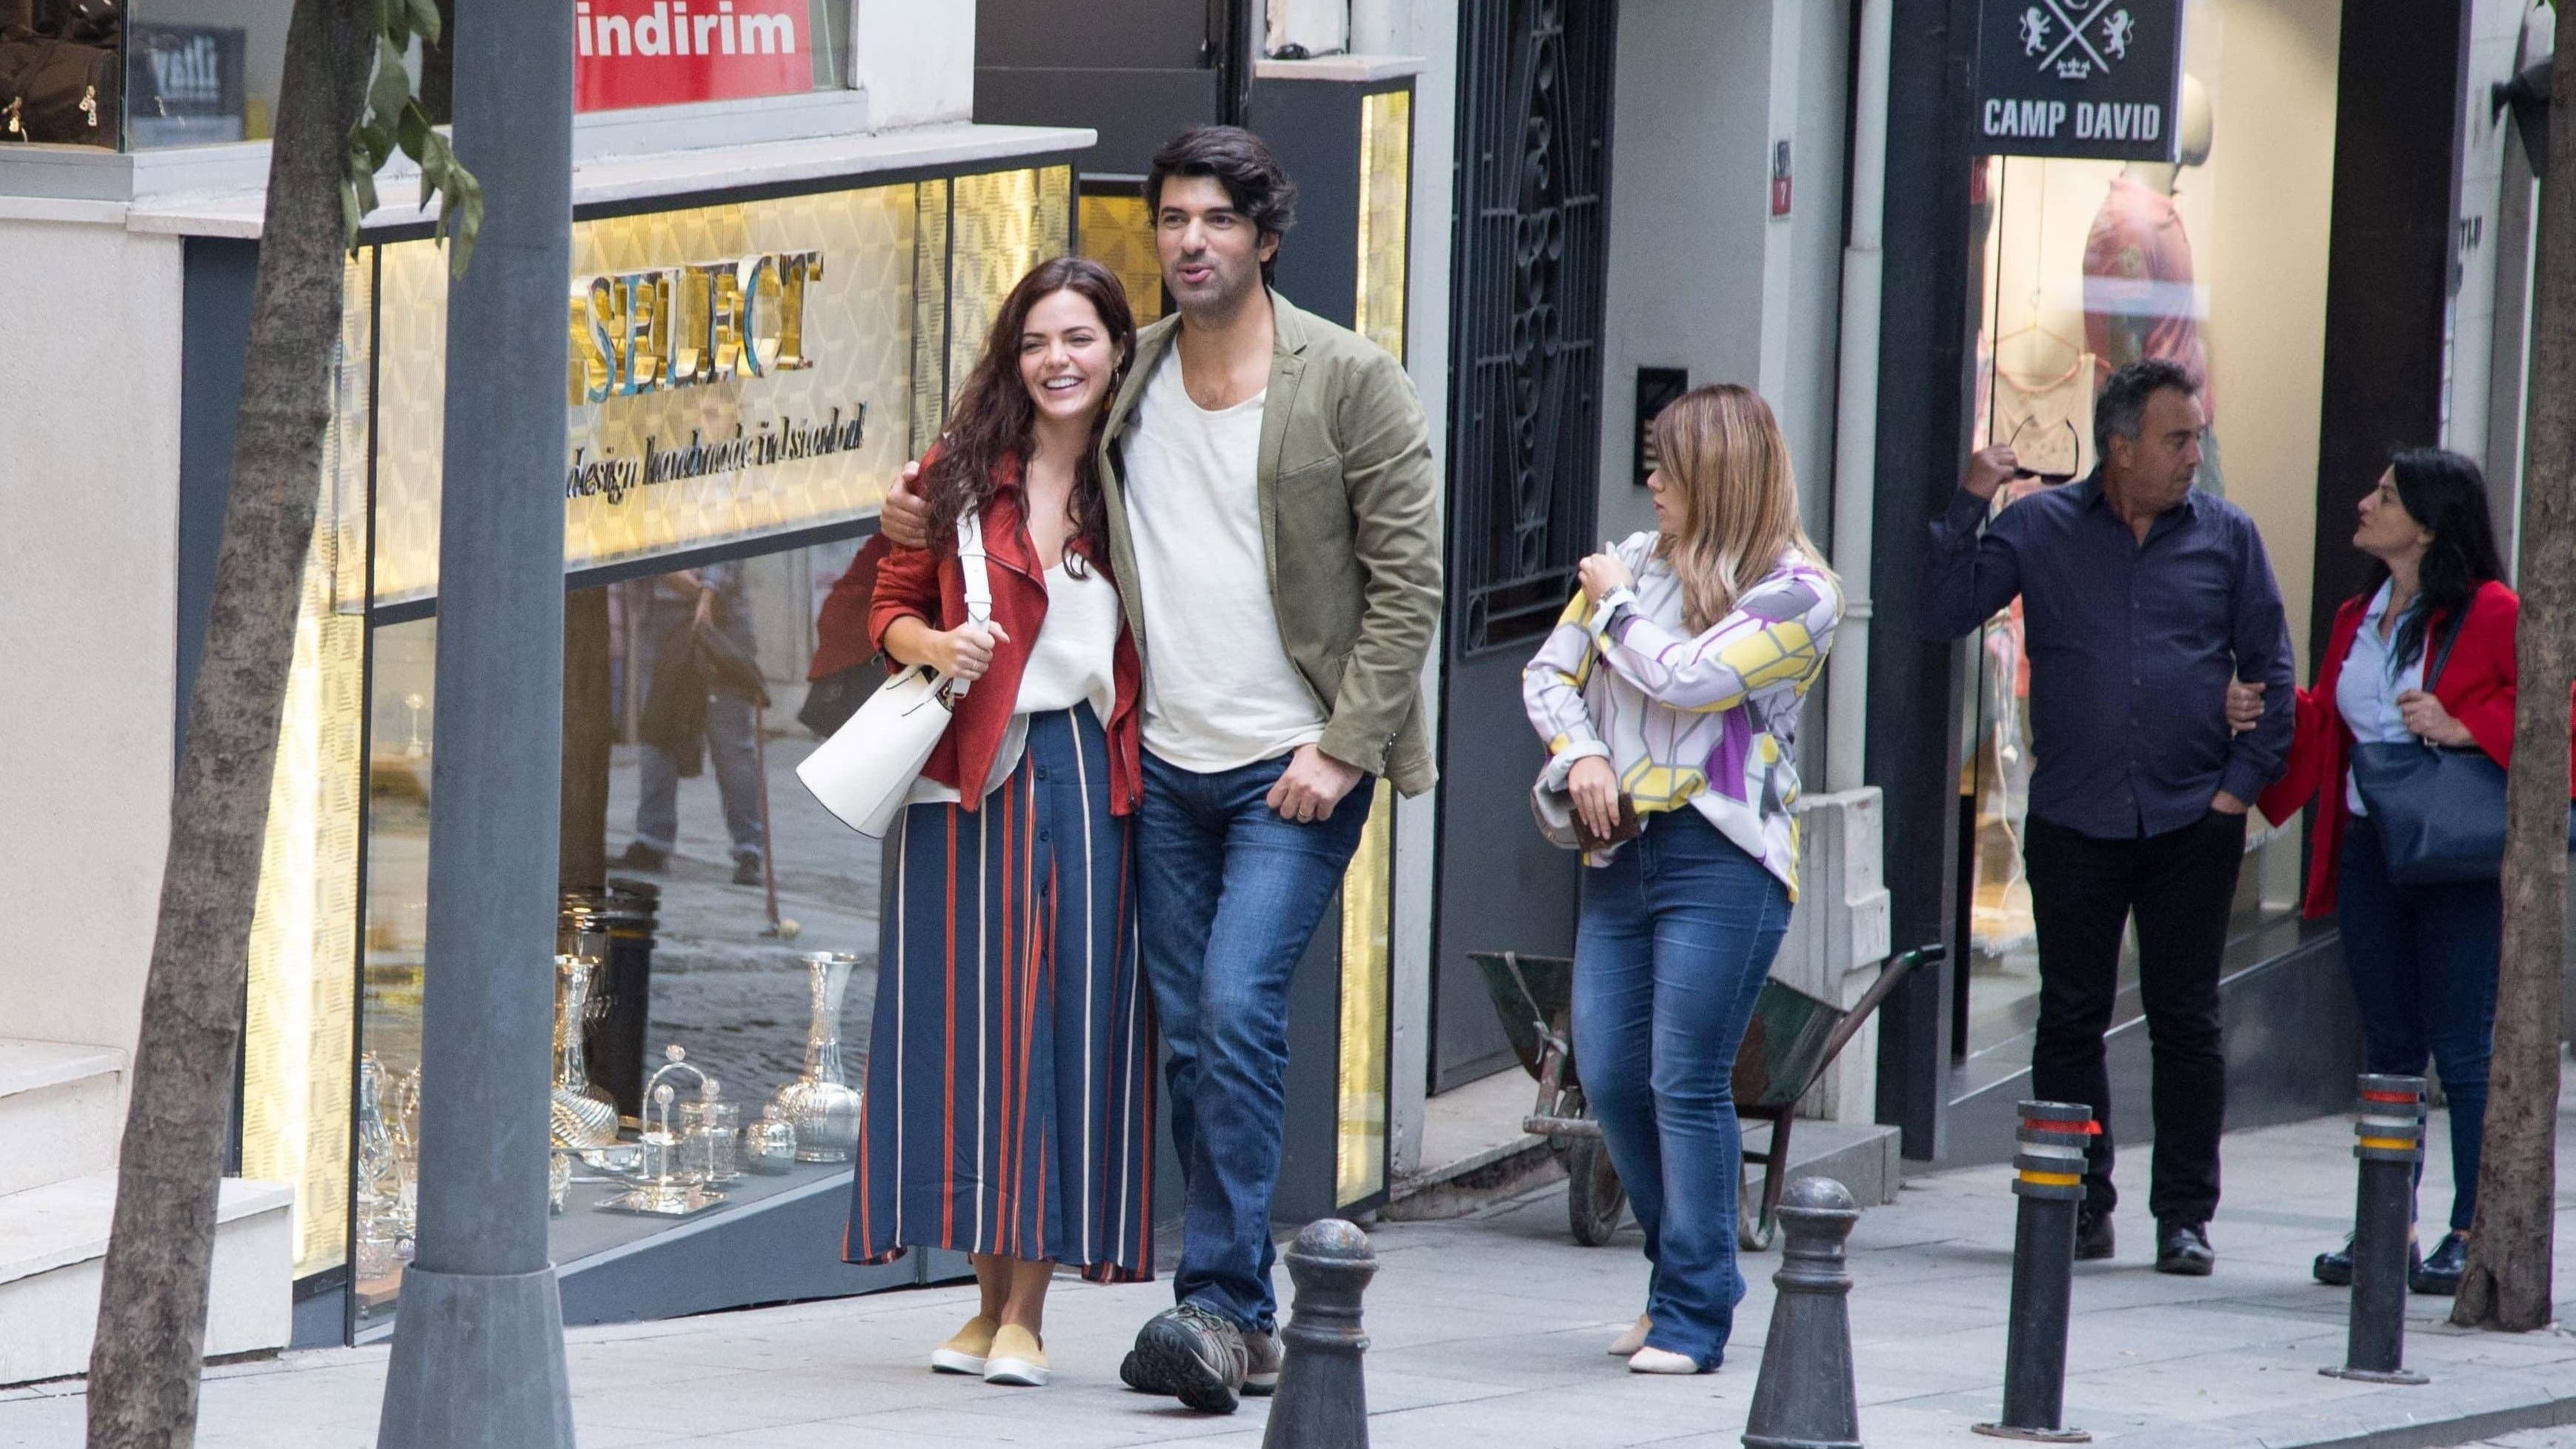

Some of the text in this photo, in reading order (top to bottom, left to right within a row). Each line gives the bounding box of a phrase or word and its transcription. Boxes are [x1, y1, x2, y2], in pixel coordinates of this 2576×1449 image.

[576, 1, 795, 56] indirim
[1984, 99, 2160, 141] CAMP DAVID
[570, 252, 824, 403] SELECT
[567, 402, 868, 505] design handmade in Istanbul
